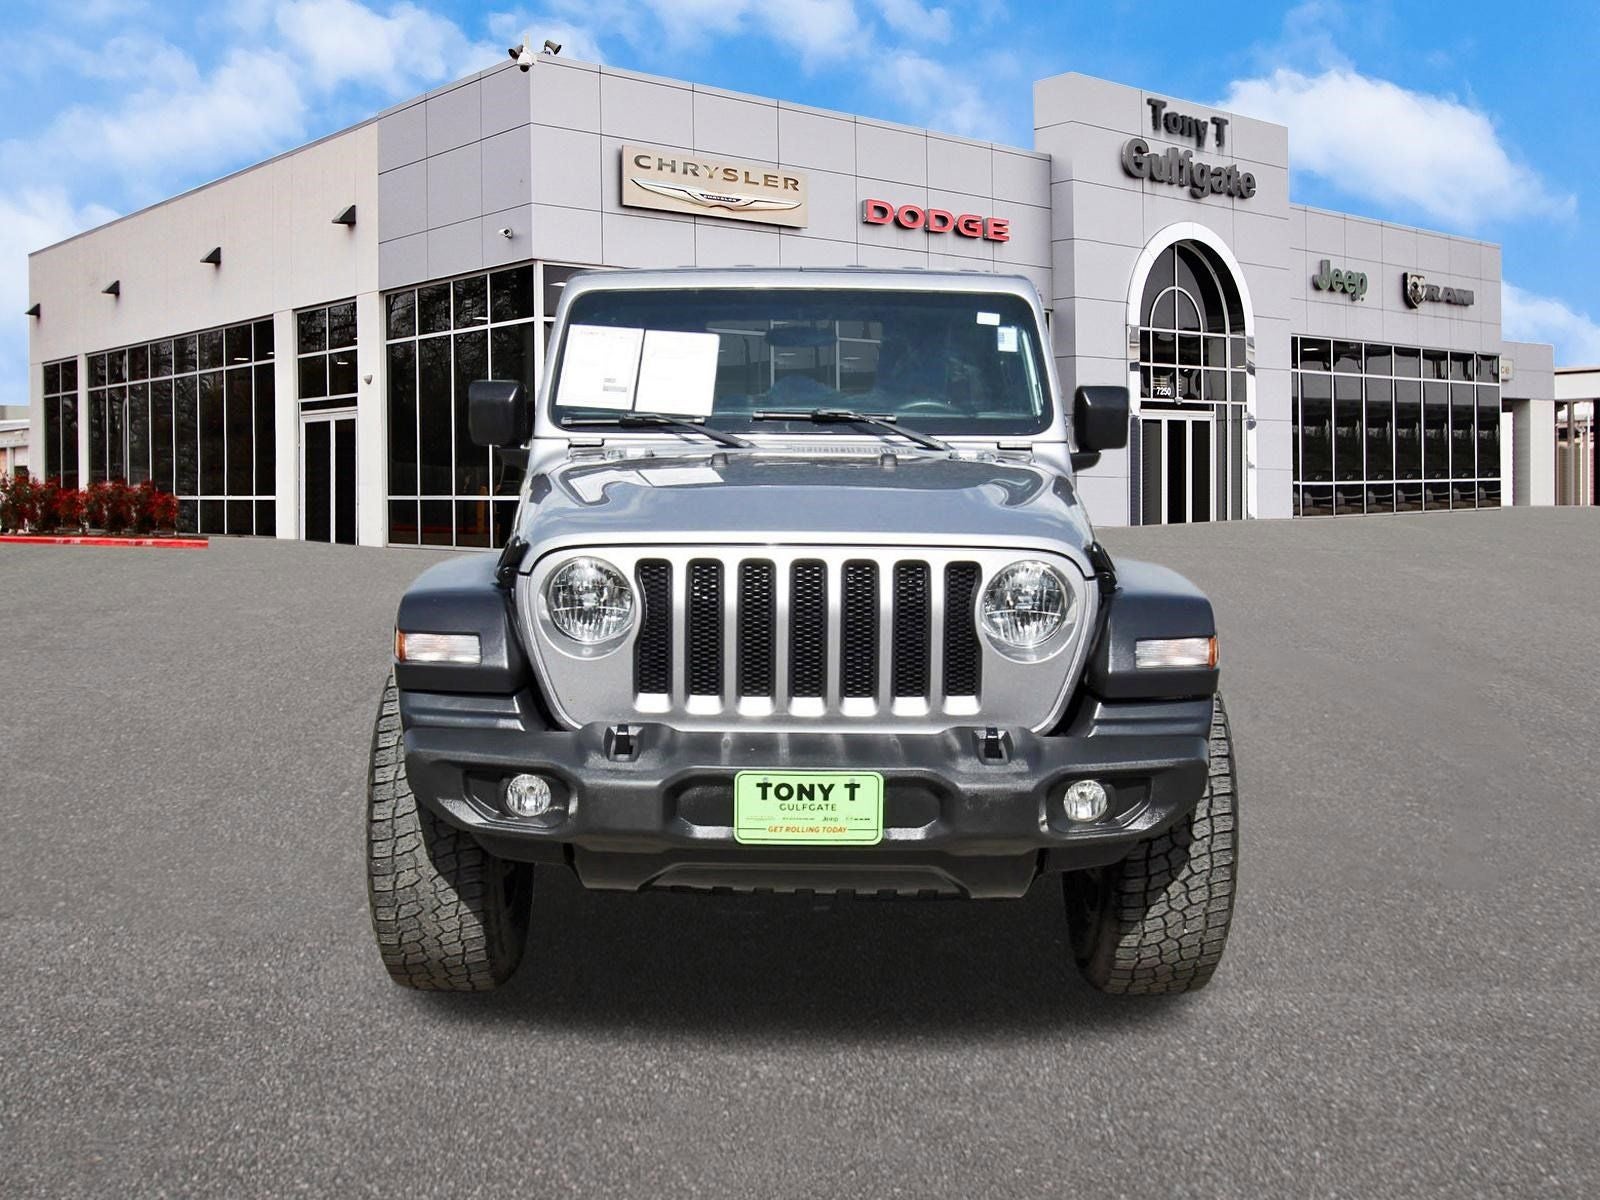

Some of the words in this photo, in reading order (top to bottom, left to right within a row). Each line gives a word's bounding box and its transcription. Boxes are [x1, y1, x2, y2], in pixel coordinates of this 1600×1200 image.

[1147, 98, 1208, 147] Tony
[1210, 116, 1229, 147] T
[634, 154, 801, 192] CHRYSLER
[1121, 138, 1256, 199] Gulfgate
[862, 198, 1011, 242] DODGE
[1312, 259, 1368, 301] Jeep
[1424, 284, 1475, 306] RAM
[1156, 386, 1172, 396] 7250
[756, 782, 835, 801] TONY
[844, 782, 861, 801] T
[779, 803, 837, 811] GULFGATE
